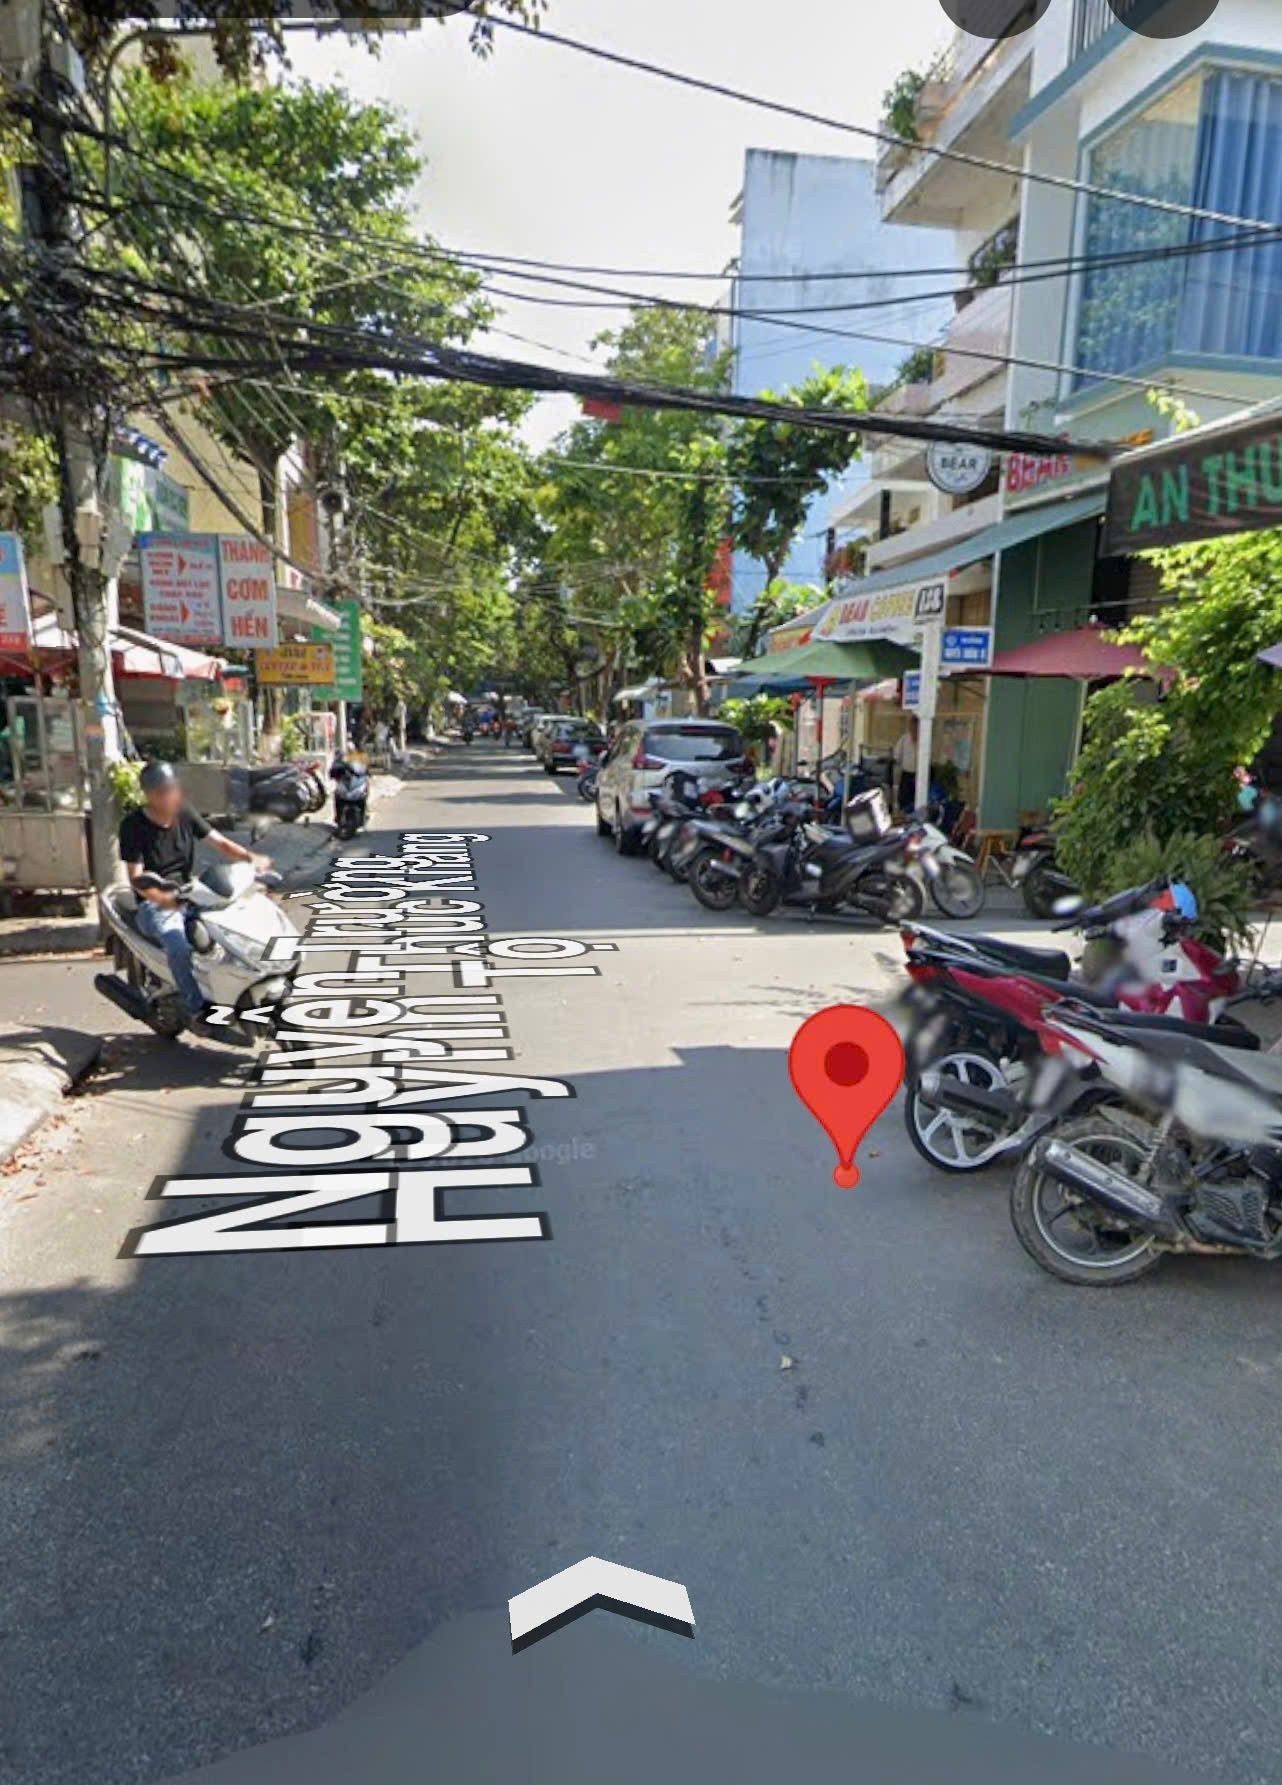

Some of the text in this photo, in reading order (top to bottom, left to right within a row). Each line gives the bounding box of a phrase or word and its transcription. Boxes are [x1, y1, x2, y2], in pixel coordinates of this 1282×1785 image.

[941, 457, 978, 469] BEAR
[1130, 462, 1190, 534] AN
[226, 577, 269, 601] CƠM
[230, 608, 269, 638] HẾN
